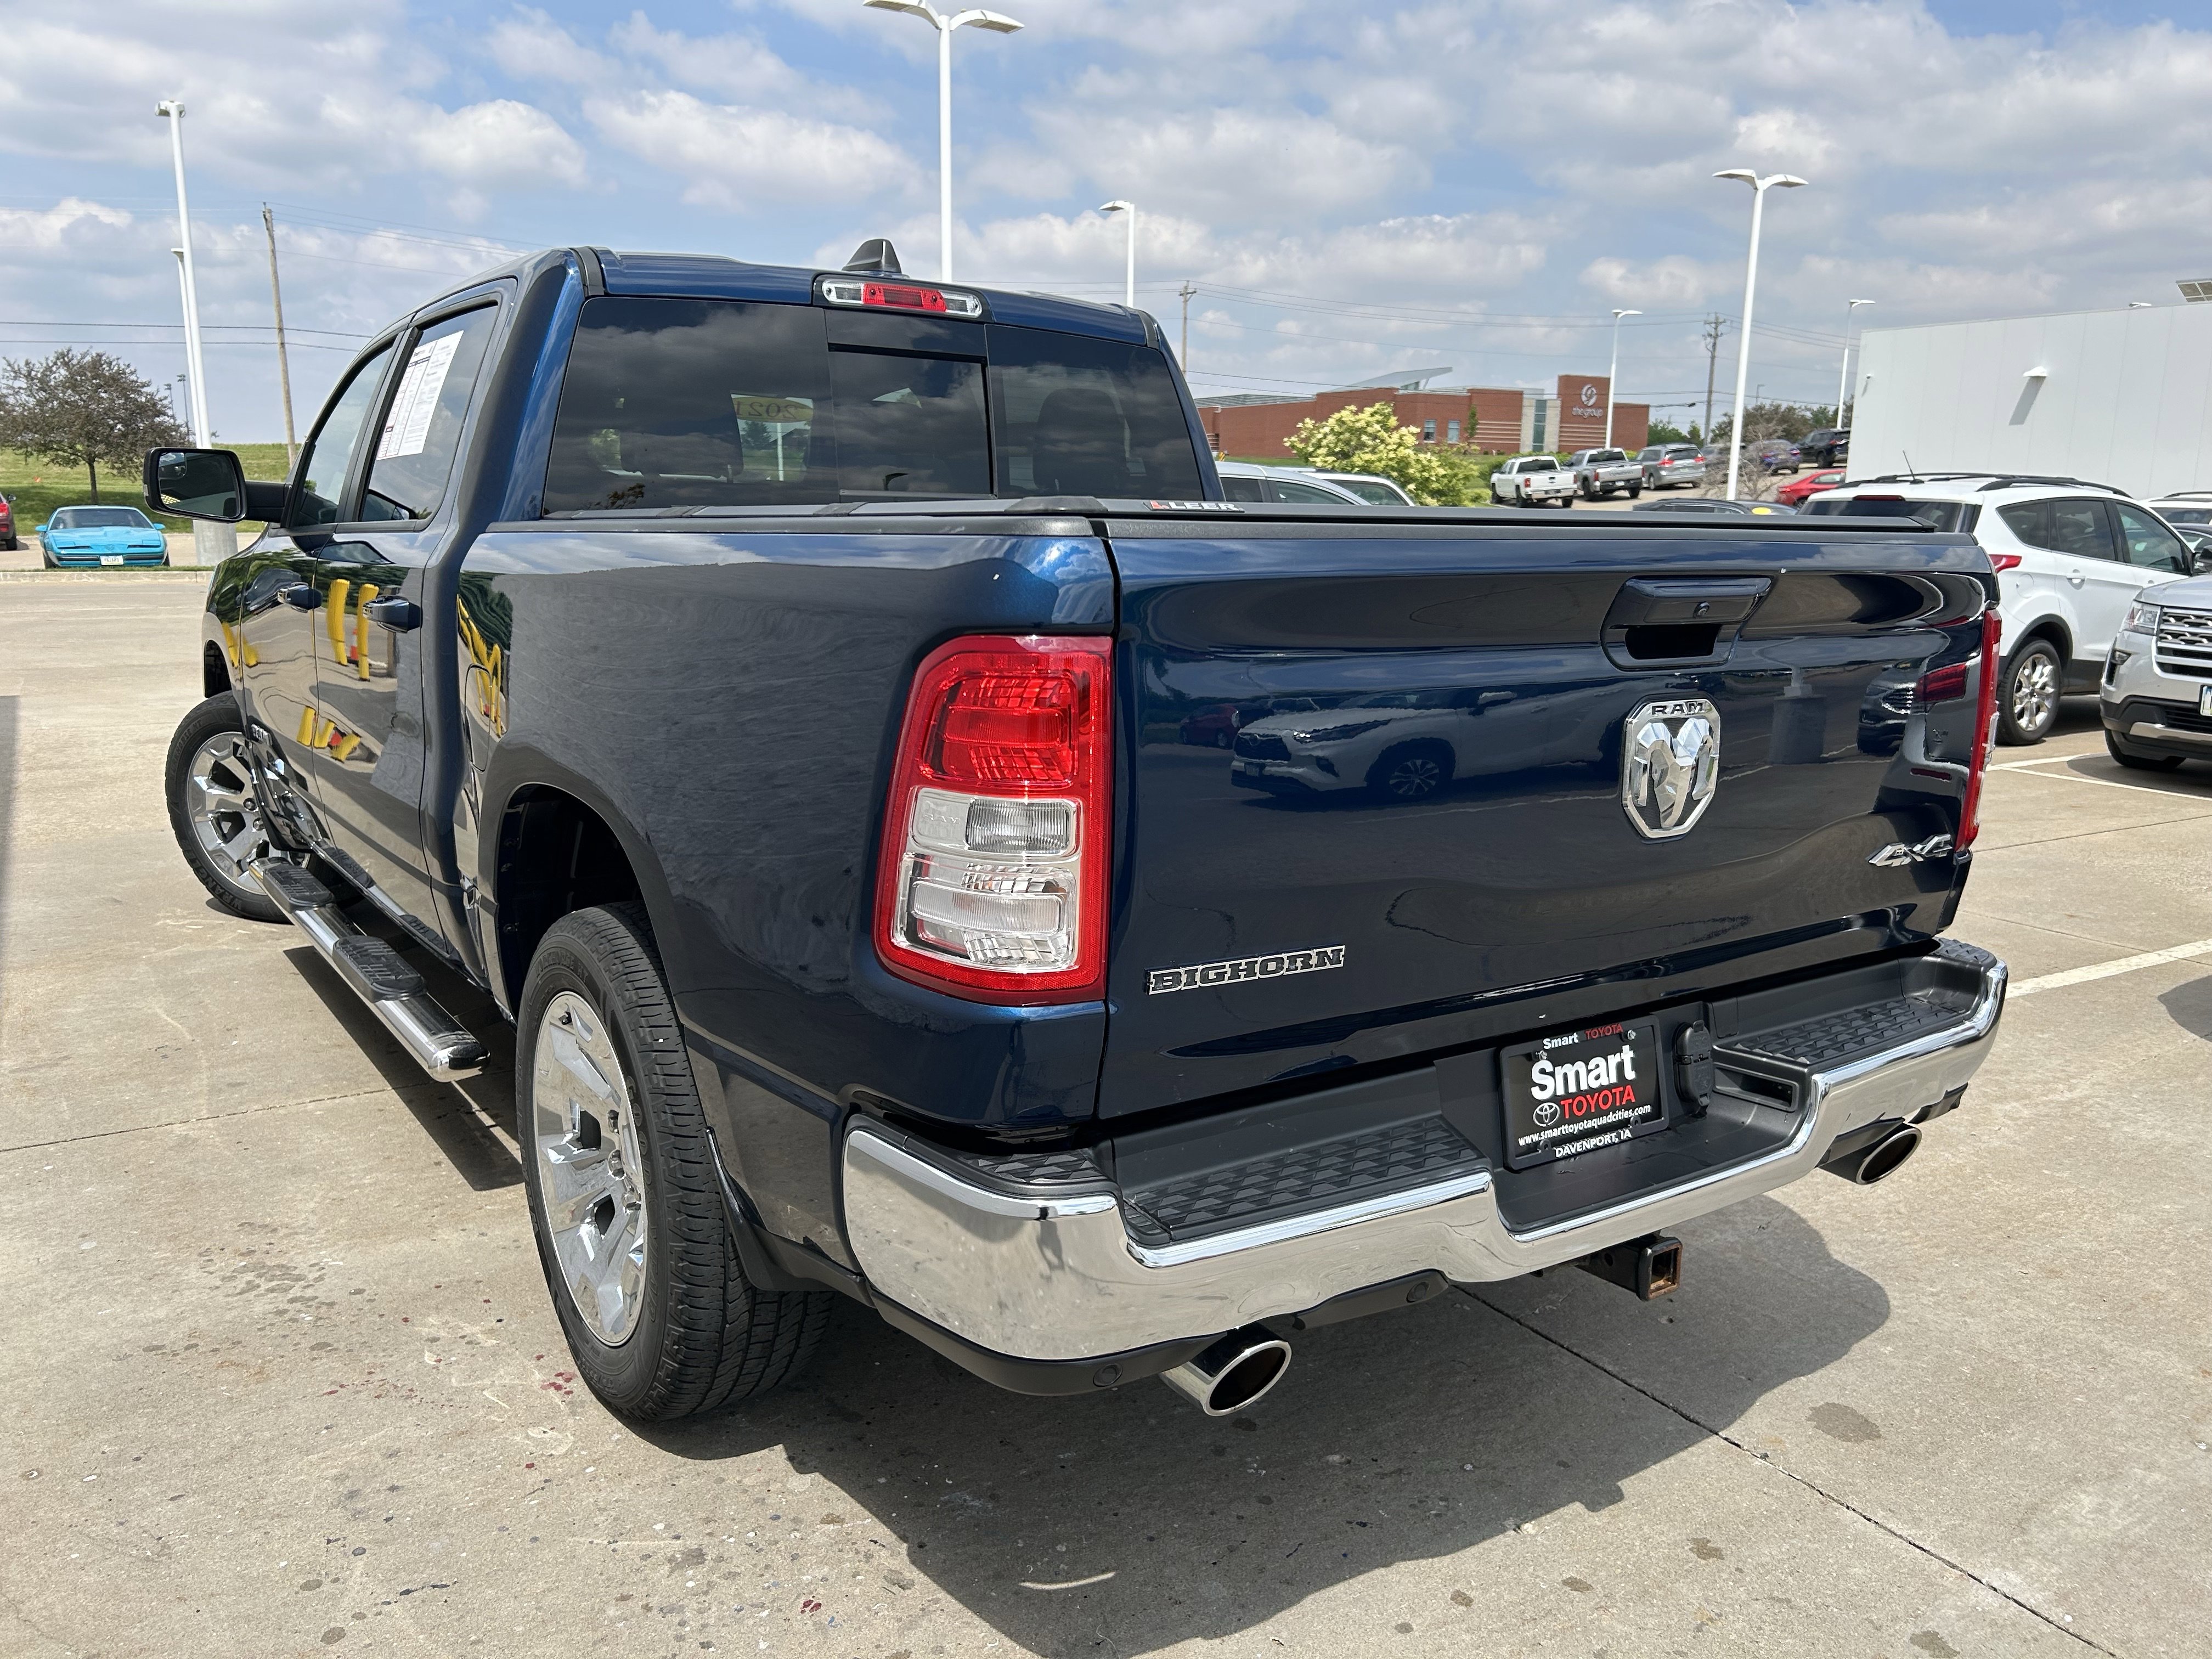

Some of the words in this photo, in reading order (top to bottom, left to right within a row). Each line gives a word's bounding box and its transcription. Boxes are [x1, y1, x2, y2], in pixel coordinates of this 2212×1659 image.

[1168, 501, 1239, 511] LEER
[1651, 701, 1706, 715] RAM
[1148, 944, 1346, 995] BIGHORN
[1543, 1032, 1579, 1049] Smart
[1585, 1023, 1624, 1040] TOYOTA
[1531, 1045, 1637, 1101] Smart
[1560, 1085, 1636, 1119] TOYOTA
[1518, 1103, 1651, 1147] www.smarttoyotaquadcities.com
[1554, 1132, 1619, 1158] DAVENPORT,
[1620, 1128, 1633, 1141] IA
